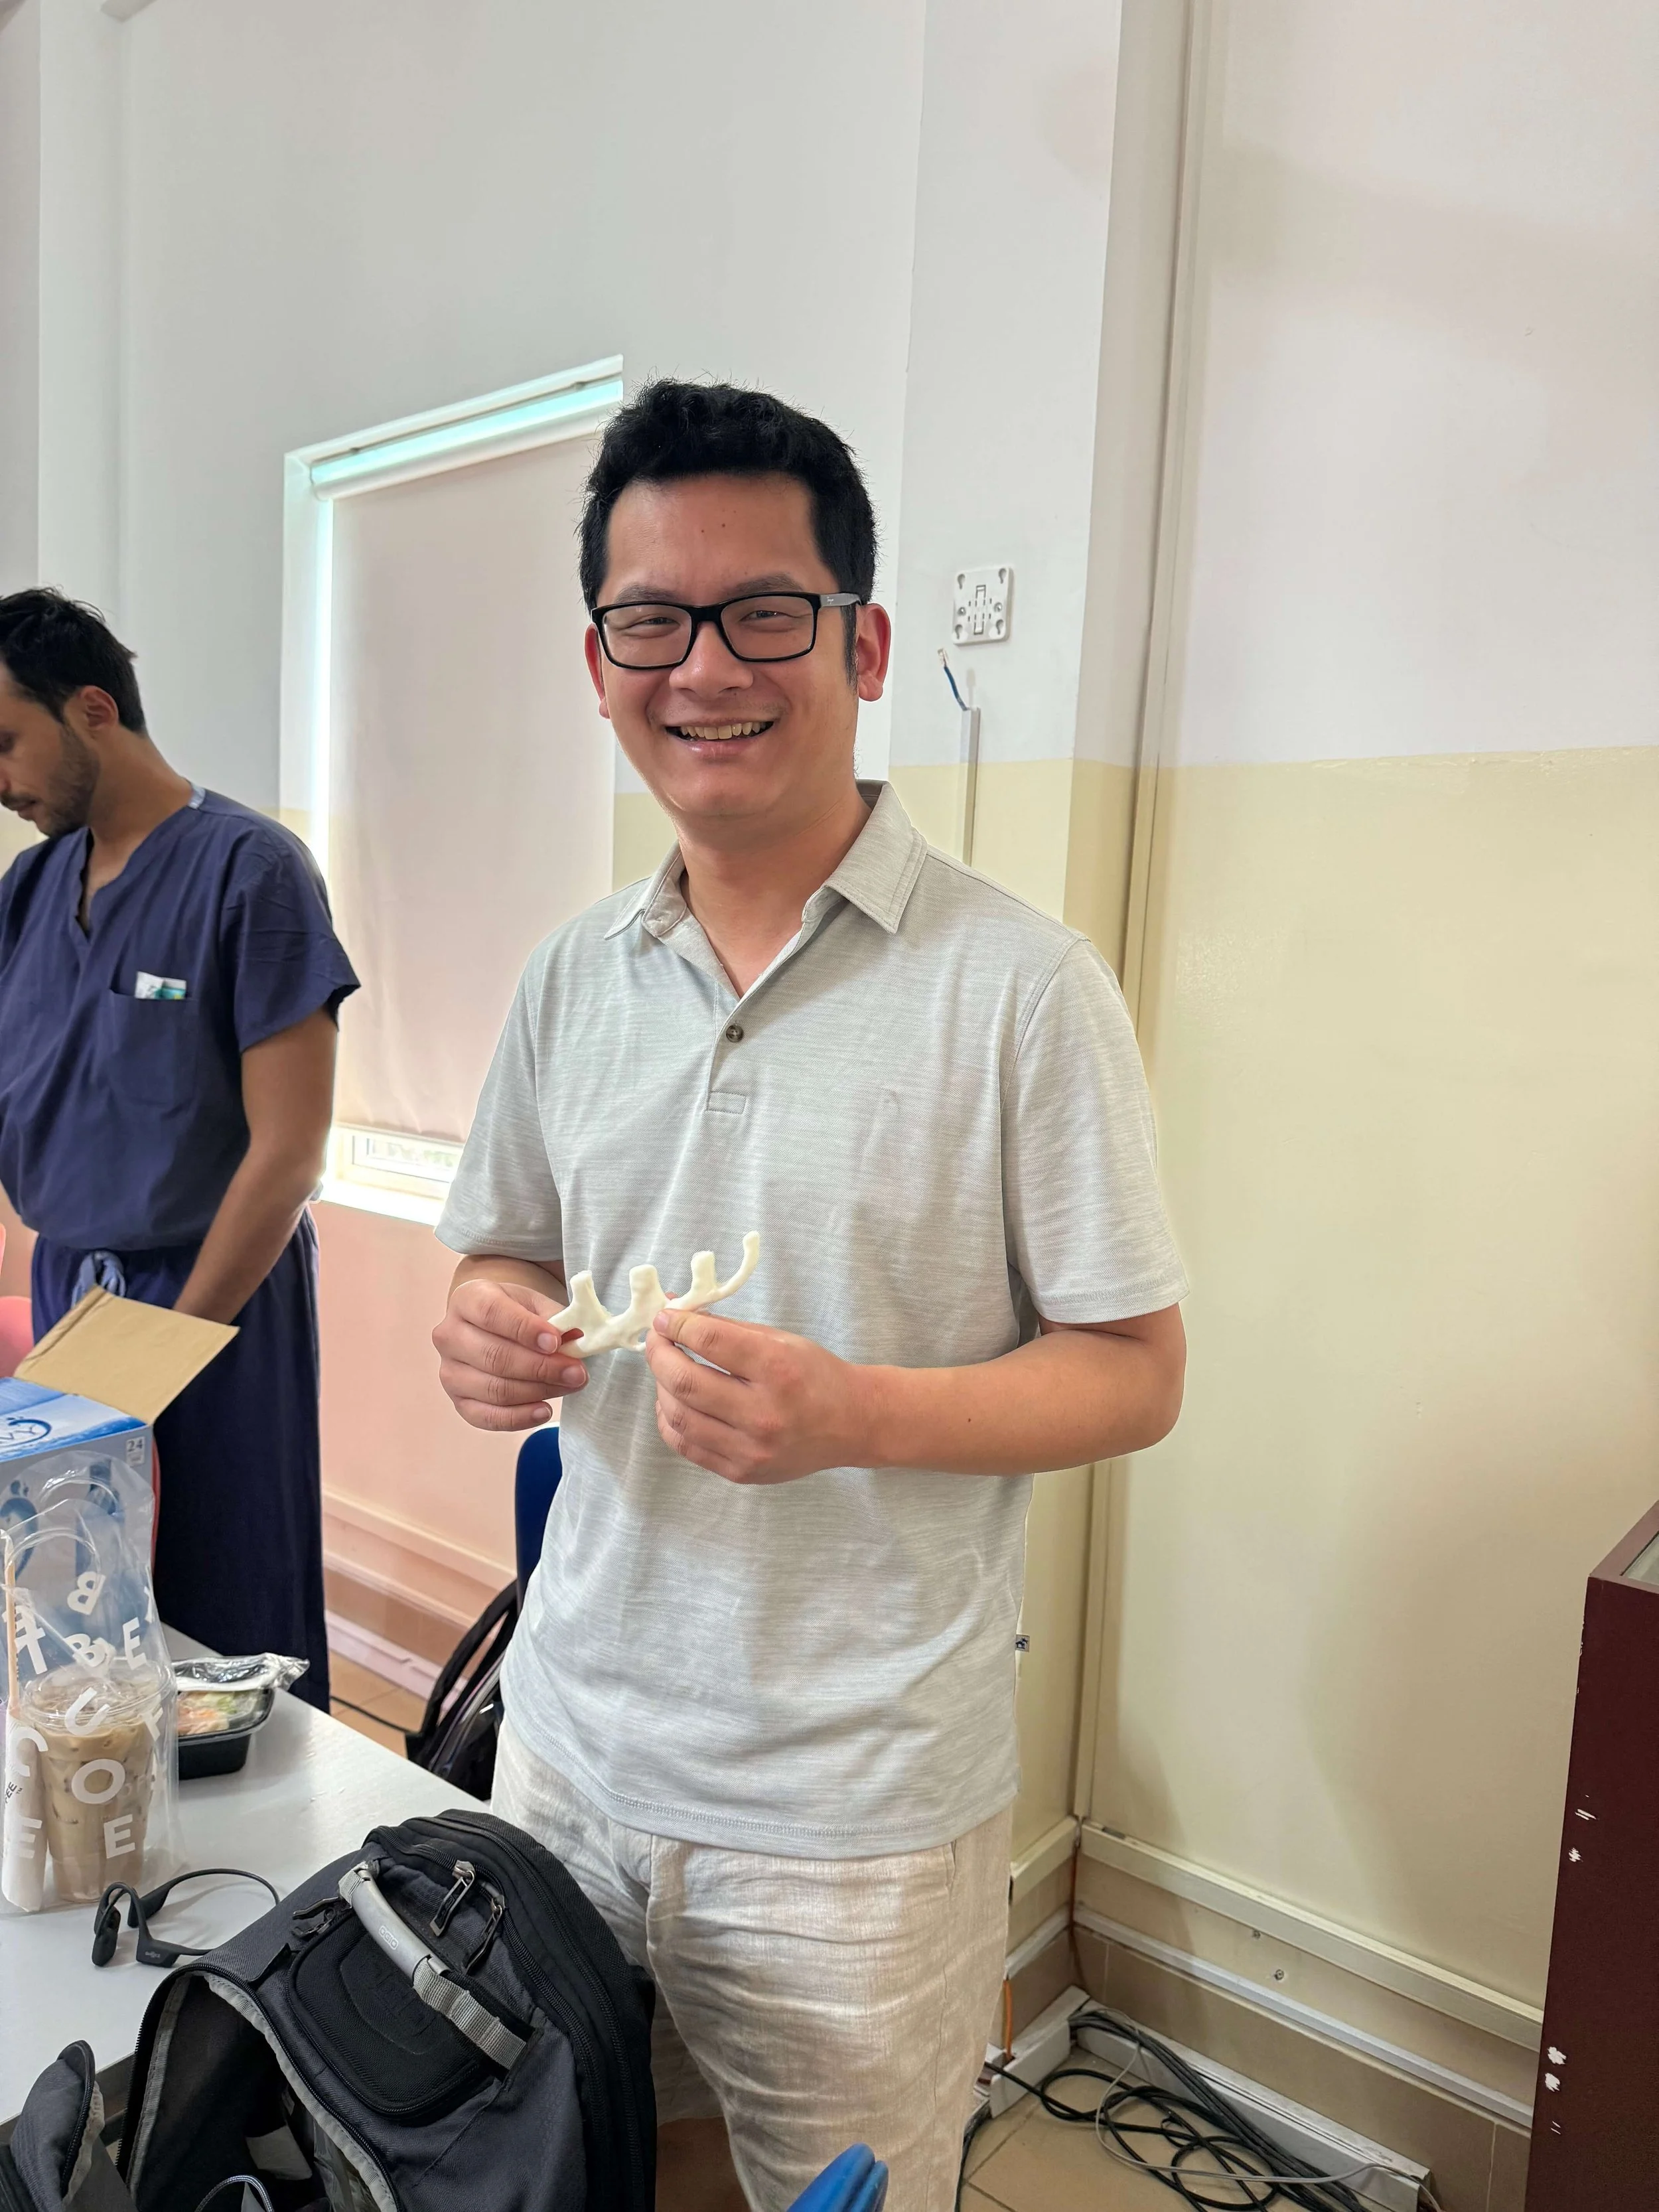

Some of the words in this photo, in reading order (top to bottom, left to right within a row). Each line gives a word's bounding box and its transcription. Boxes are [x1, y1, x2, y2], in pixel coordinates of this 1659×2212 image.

[127, 1439, 143, 1452] 24
[122, 1617, 147, 1670] E
[71, 1759, 125, 1804] O
[104, 1814, 135, 1858] E
